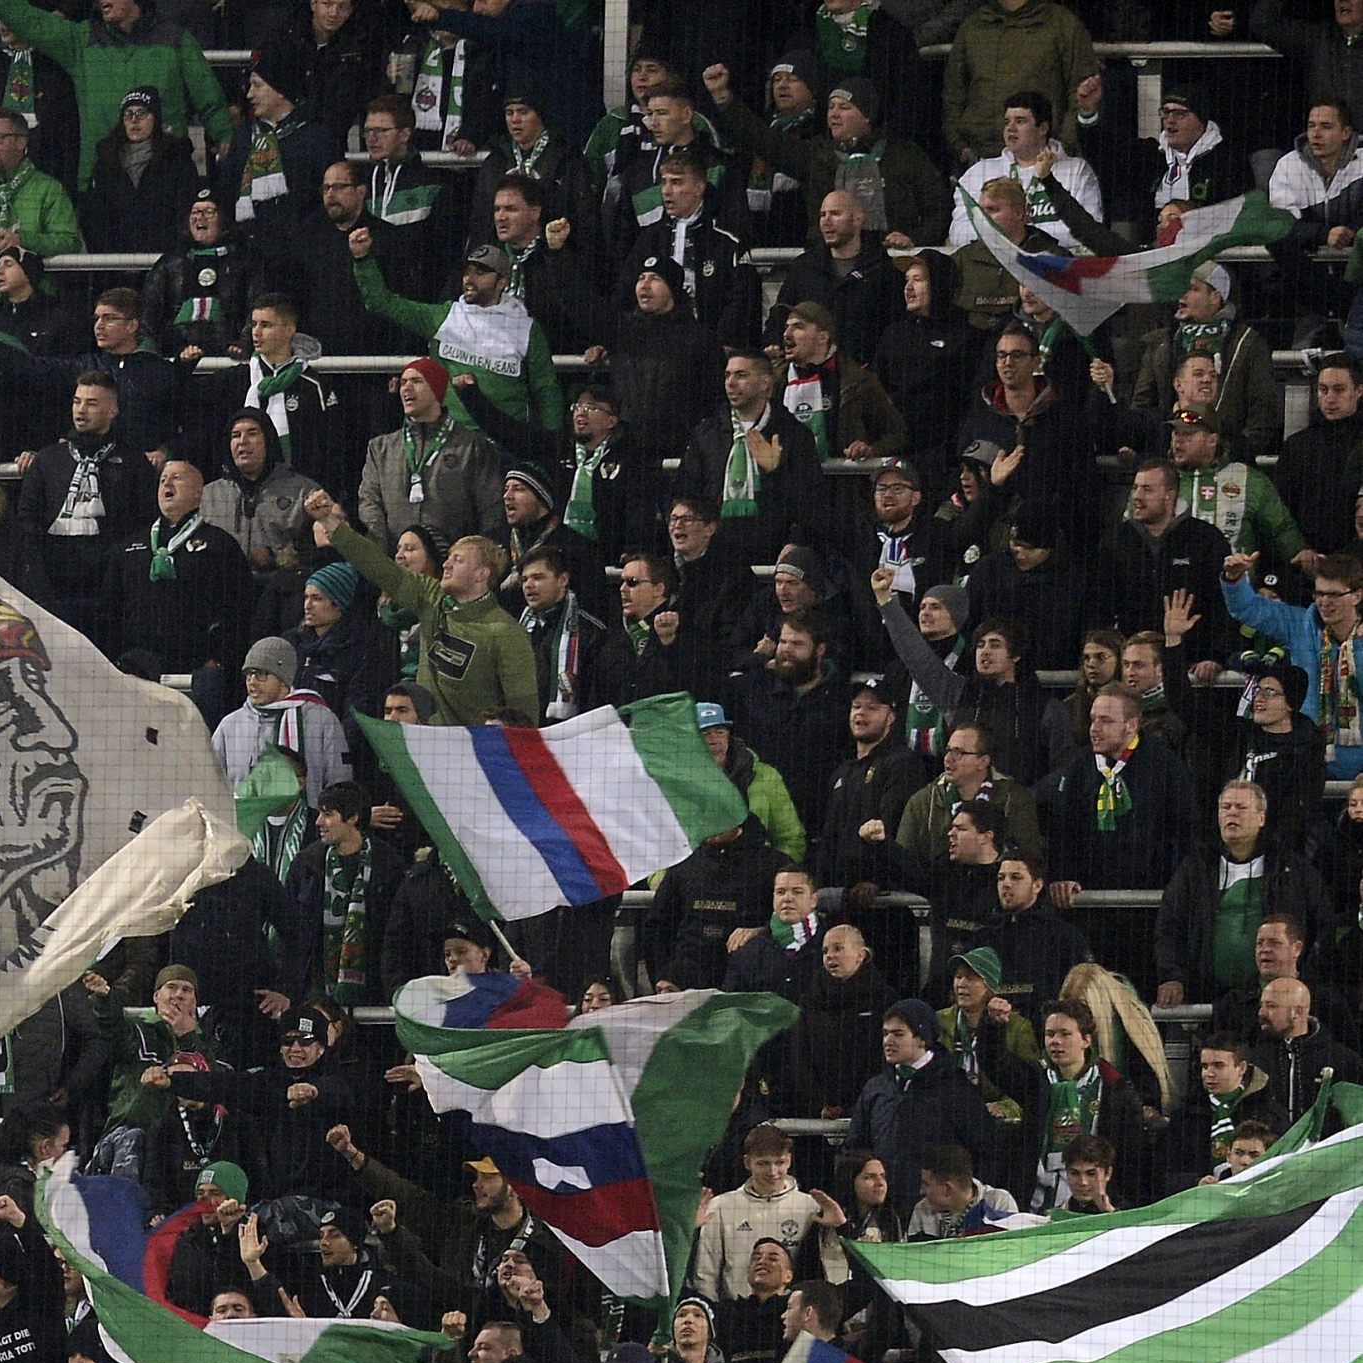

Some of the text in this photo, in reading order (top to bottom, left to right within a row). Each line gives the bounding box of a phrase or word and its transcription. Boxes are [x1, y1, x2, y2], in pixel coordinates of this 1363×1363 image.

[442, 344, 518, 375] CALVIN KLEIN JEANS
[13, 1328, 31, 1341] DIE
